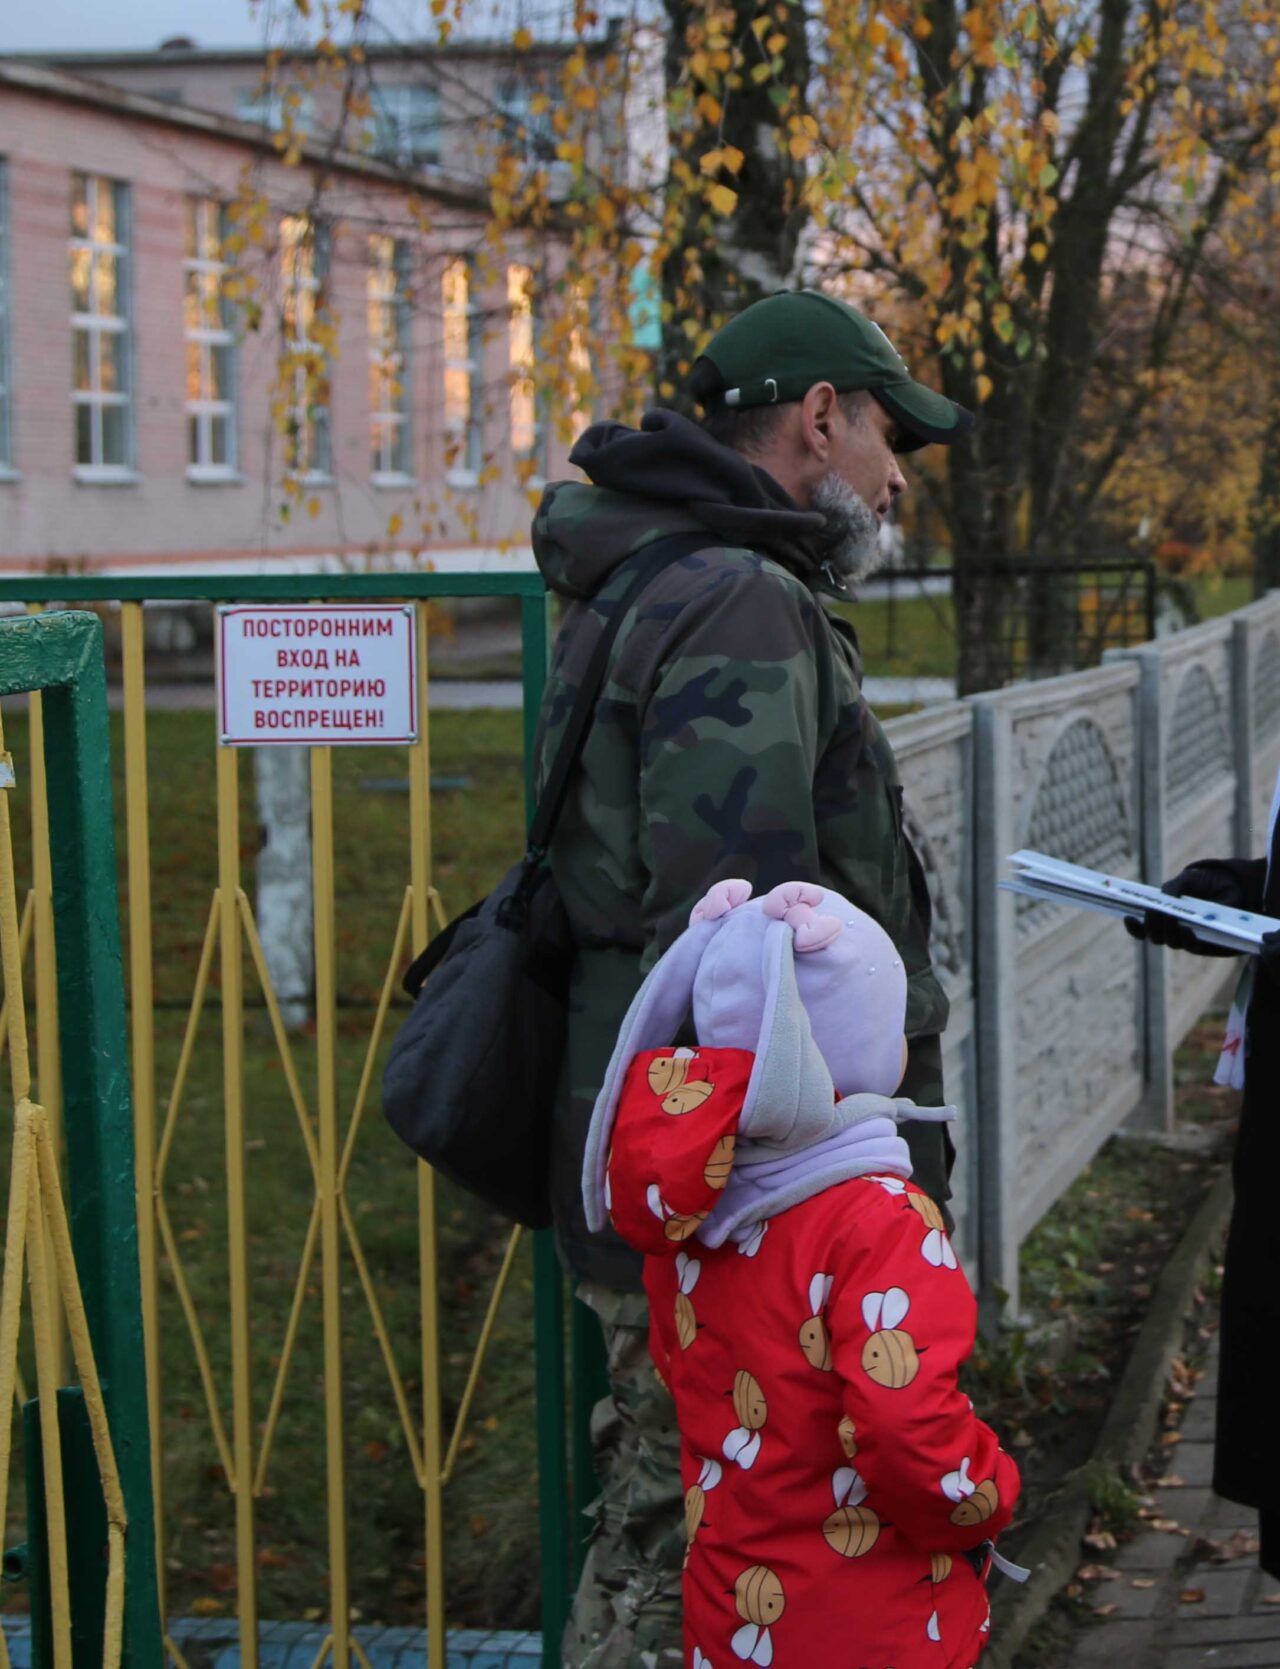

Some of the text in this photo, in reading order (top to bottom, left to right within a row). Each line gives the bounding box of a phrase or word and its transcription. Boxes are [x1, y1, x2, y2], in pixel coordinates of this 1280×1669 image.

[243, 618, 393, 637] ПОСТОРОННИМ
[277, 649, 361, 669] ВХОД НА
[252, 679, 386, 698] ТЕРРИТОРИЮ
[254, 709, 384, 730] ВОСПРЕЩЕН!
